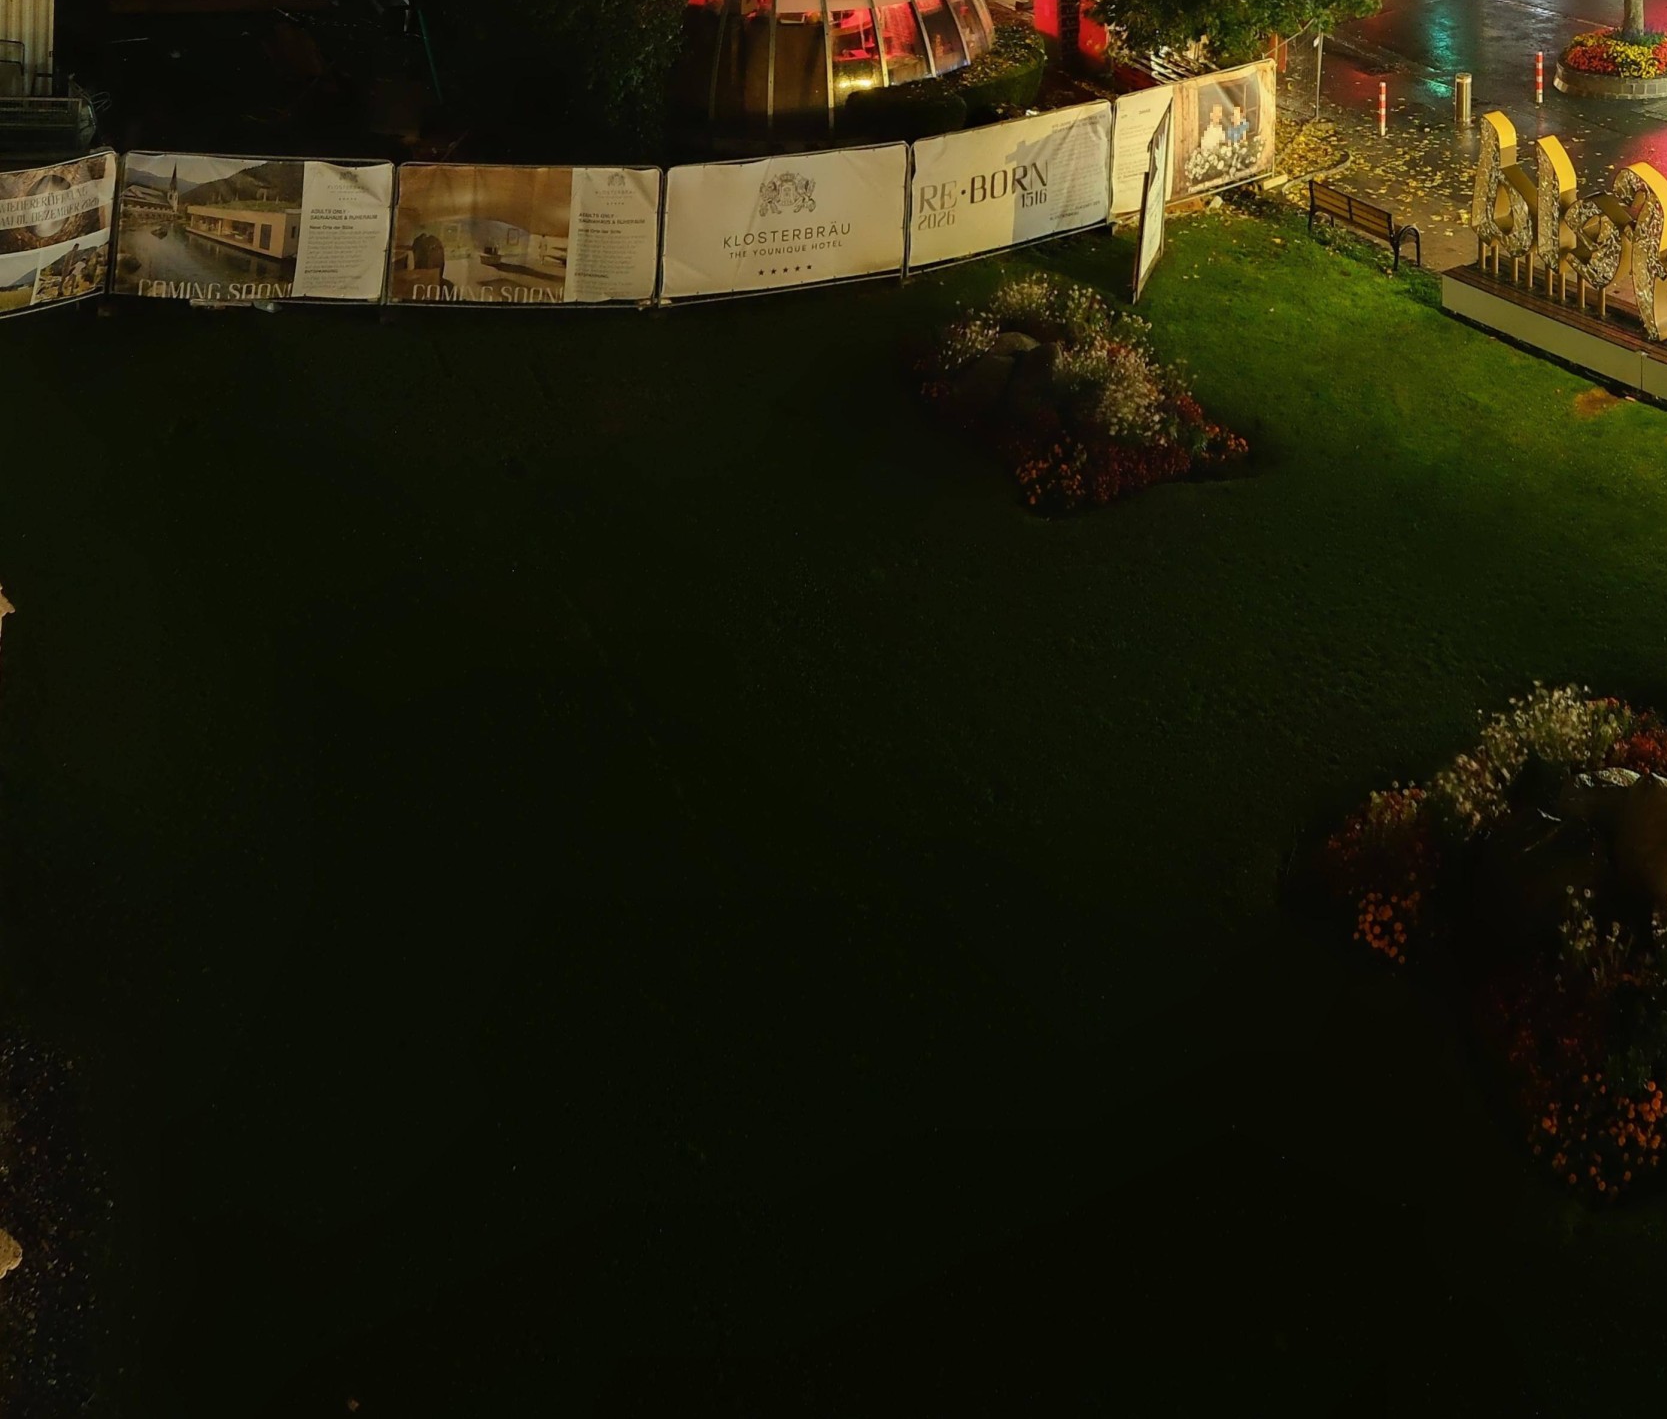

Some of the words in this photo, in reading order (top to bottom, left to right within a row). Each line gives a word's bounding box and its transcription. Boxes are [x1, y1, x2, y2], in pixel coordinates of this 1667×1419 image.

[1021, 189, 1048, 209] 1516
[917, 210, 956, 231] 2026
[723, 221, 851, 249] KLOSTERBRÄU
[729, 251, 747, 259] THE
[753, 244, 807, 256] YOUNIQUE
[811, 240, 843, 250] HOTEL
[138, 279, 221, 299] COMING
[412, 284, 493, 301] COMING
